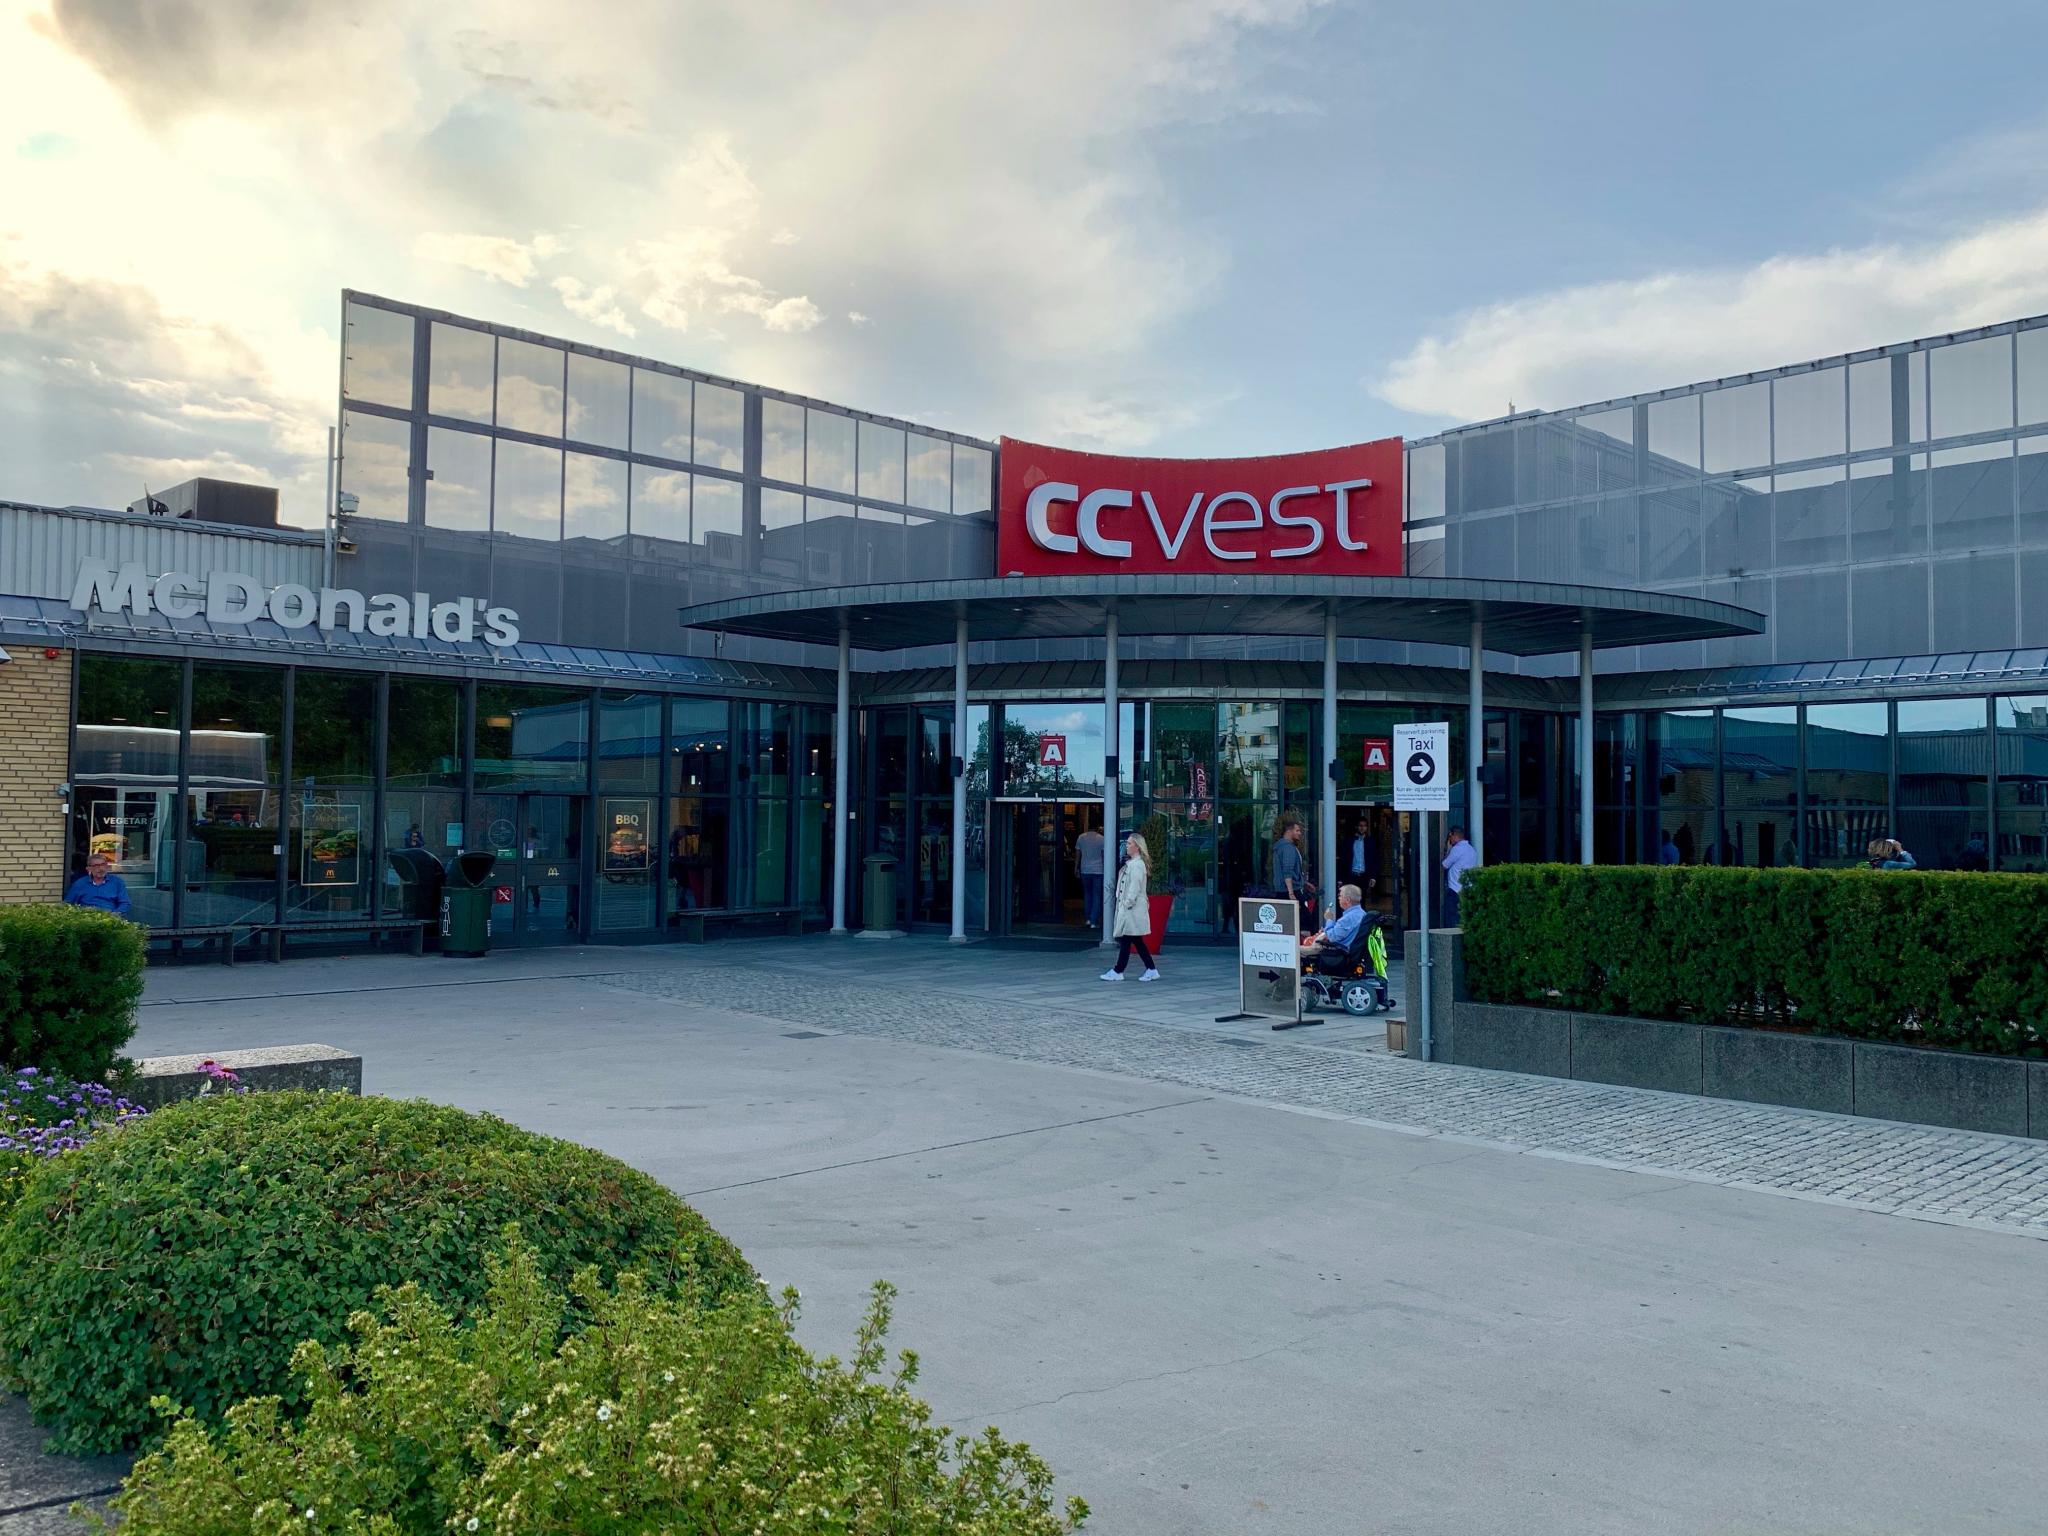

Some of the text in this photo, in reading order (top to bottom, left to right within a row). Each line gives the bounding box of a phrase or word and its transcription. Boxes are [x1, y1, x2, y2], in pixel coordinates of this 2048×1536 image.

[69, 555, 520, 647] McDonald's
[1408, 736, 1434, 750] Taxi
[1043, 744, 1063, 762] A
[1367, 747, 1386, 766] A
[103, 817, 148, 825] VEGETAR
[615, 814, 639, 826] BBQ
